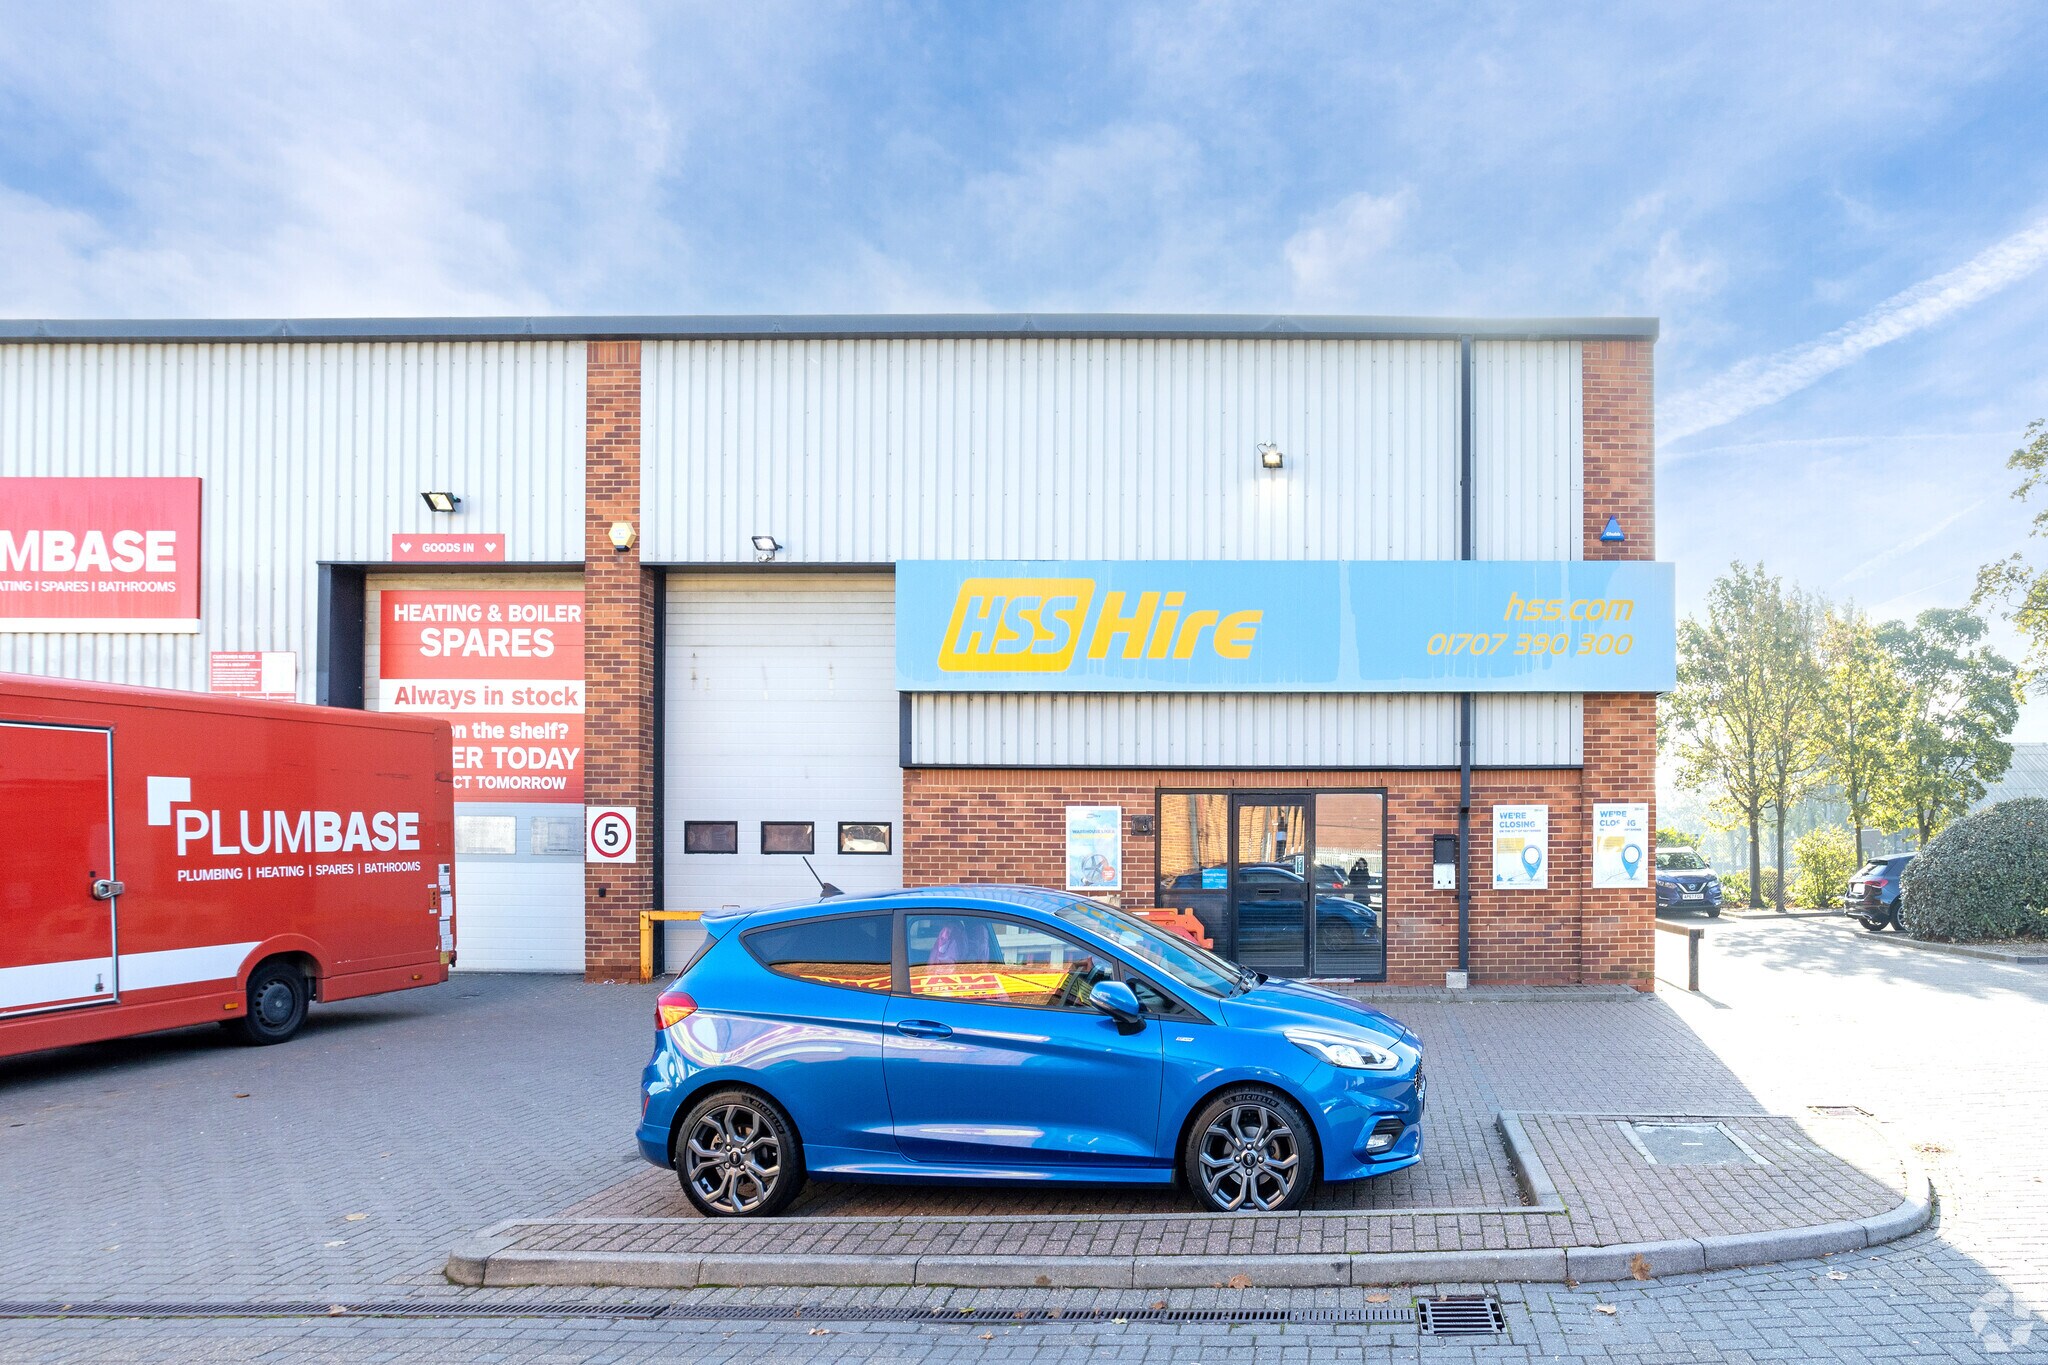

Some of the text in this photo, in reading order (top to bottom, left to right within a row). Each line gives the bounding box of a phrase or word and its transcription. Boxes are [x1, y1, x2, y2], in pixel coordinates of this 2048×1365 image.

[422, 543, 474, 553] GOODS IN
[41, 581, 89, 593] SPARES
[98, 581, 177, 593] BATHROOMS
[394, 604, 581, 623] HEATING & BOILER
[1503, 592, 1634, 621] hss.com
[953, 591, 1264, 659] HSS Hire
[419, 627, 555, 658] SPARES
[1427, 633, 1634, 655] 01707 390 300
[394, 685, 578, 709] Always in stock
[471, 721, 505, 740] the
[509, 722, 569, 740] shelf?
[452, 746, 580, 770] ER TODAY
[453, 775, 567, 790] CT TOMORROW
[1499, 812, 1527, 820] WE'RE
[1499, 820, 1536, 828] CLOSING
[176, 809, 420, 856] PLUMBASE
[603, 822, 619, 847] 5
[177, 861, 421, 882] PLUMBING HEATING SPARES BATHROOMS
[1235, 1094, 1278, 1106] MICHELIN
[751, 1100, 784, 1132] MICHELIN
